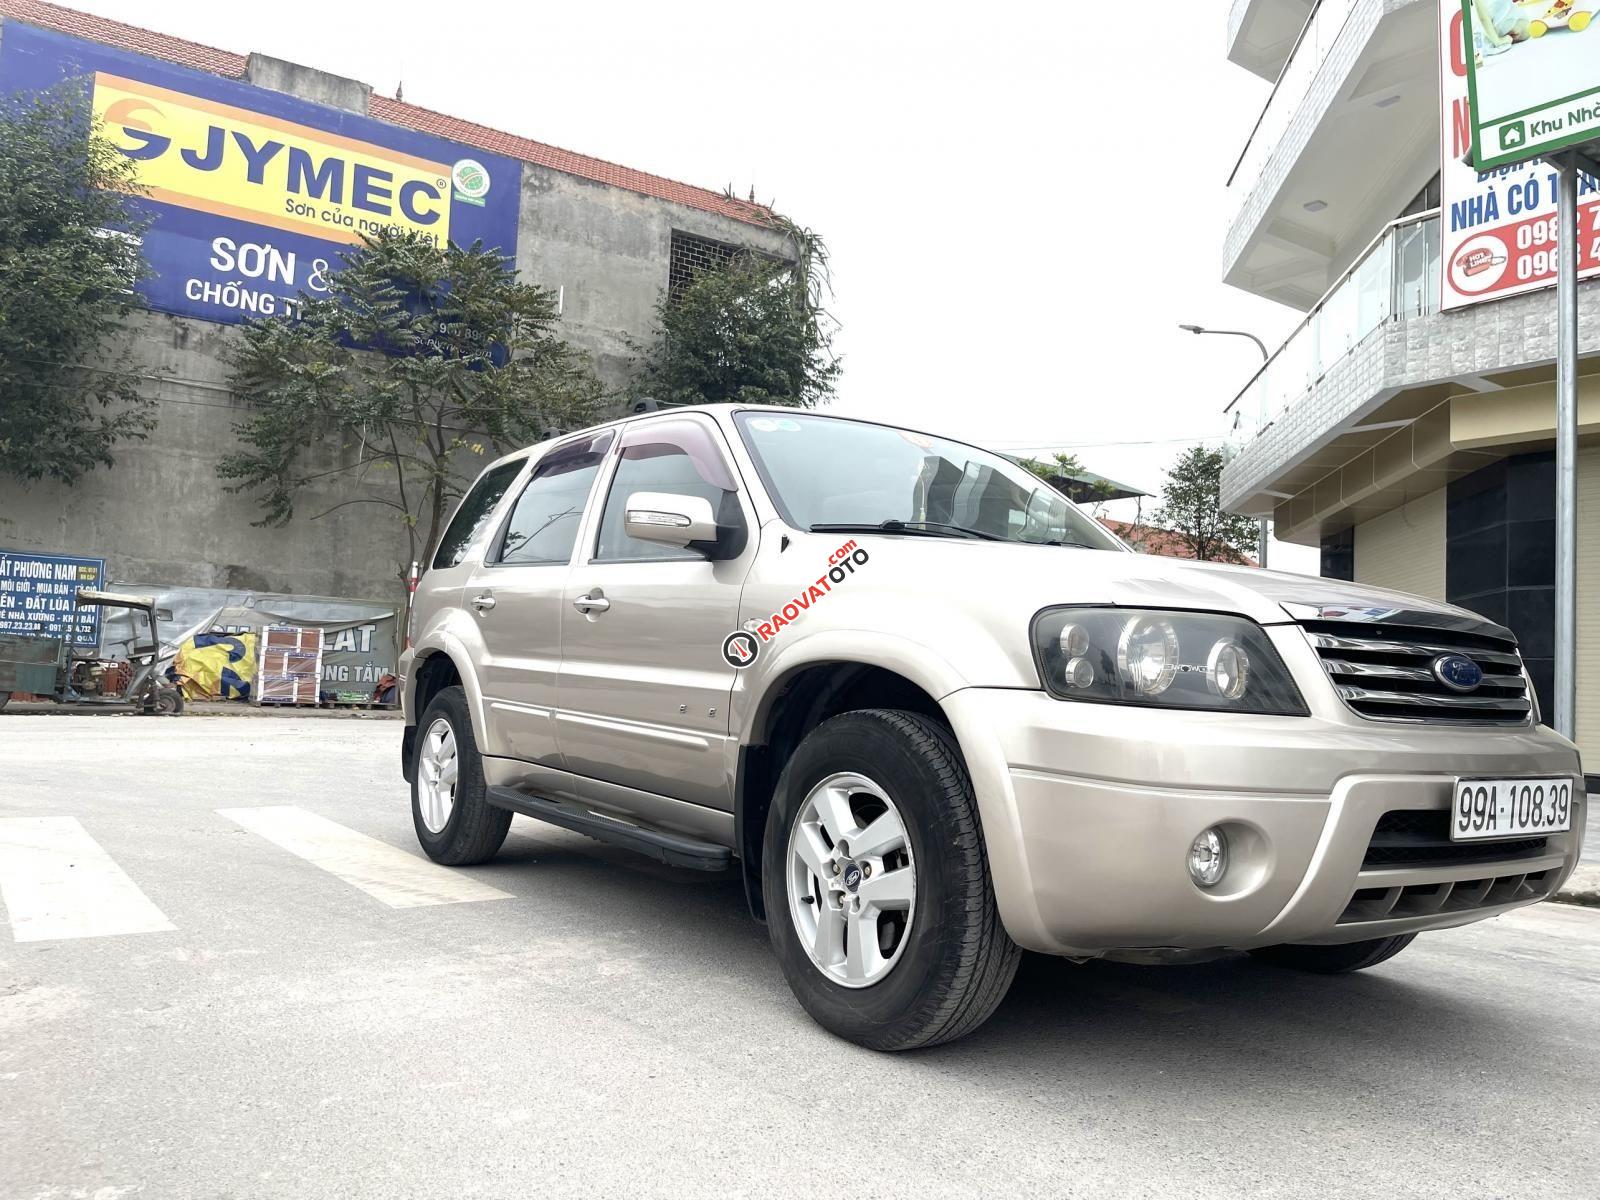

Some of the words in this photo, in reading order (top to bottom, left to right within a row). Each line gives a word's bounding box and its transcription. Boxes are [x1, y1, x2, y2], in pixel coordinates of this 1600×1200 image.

[1530, 118, 1563, 138] Khu
[180, 125, 441, 226] JYMEC
[285, 198, 316, 219] Sơn
[321, 207, 354, 227] của
[1451, 185, 1500, 233] NHÀ
[1507, 172, 1540, 216] CÓ
[209, 236, 296, 285] SƠN
[185, 278, 275, 314] CHỐNG
[13, 560, 53, 580] PHƯƠNG
[54, 564, 77, 581] NAM
[36, 582, 53, 594] MUA
[54, 581, 69, 595] BÁN
[8, 610, 26, 621] NHÀ
[25, 594, 47, 611] ĐẤT
[49, 596, 70, 612] LÚA
